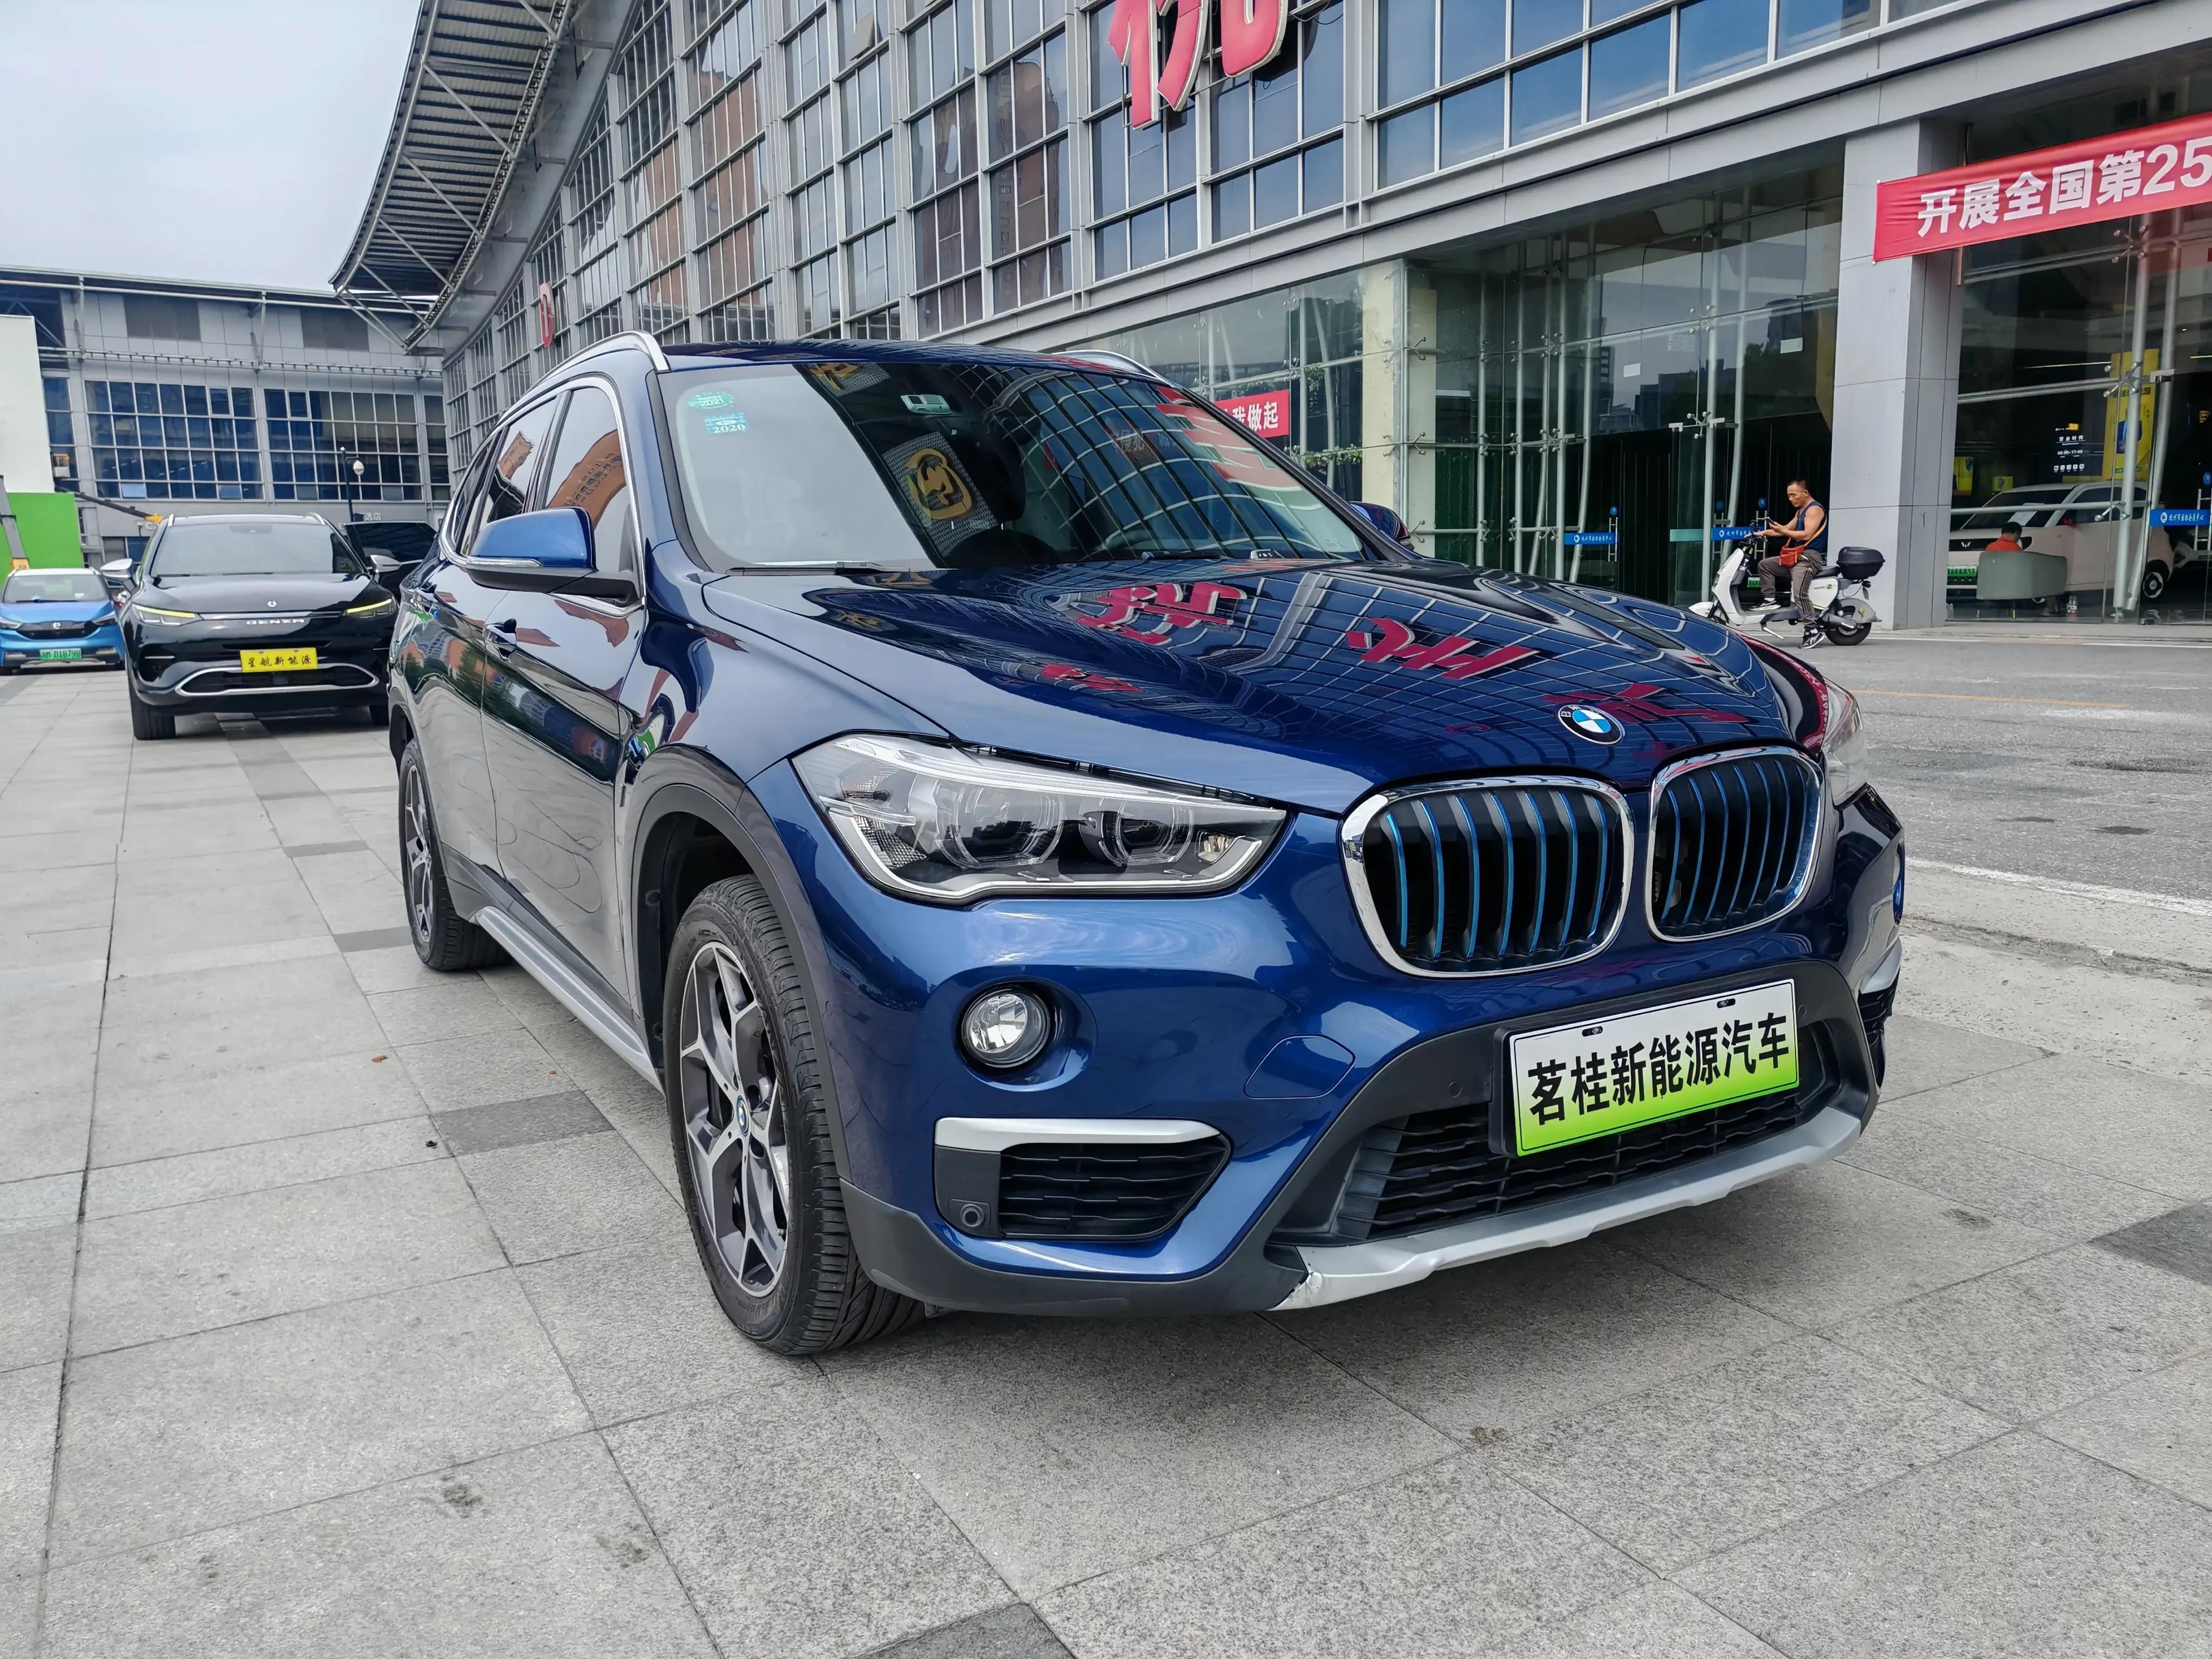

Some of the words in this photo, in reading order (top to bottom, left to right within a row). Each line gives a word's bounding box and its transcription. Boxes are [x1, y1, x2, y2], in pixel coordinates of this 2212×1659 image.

[1918, 137, 2212, 238] 开展全国第25
[699, 398, 724, 407] 2021
[1224, 401, 1279, 431] 我做起
[712, 424, 746, 433] 2020
[248, 655, 312, 668] 星航新能源
[1528, 1012, 1790, 1125] 茗桂新能源汽车
